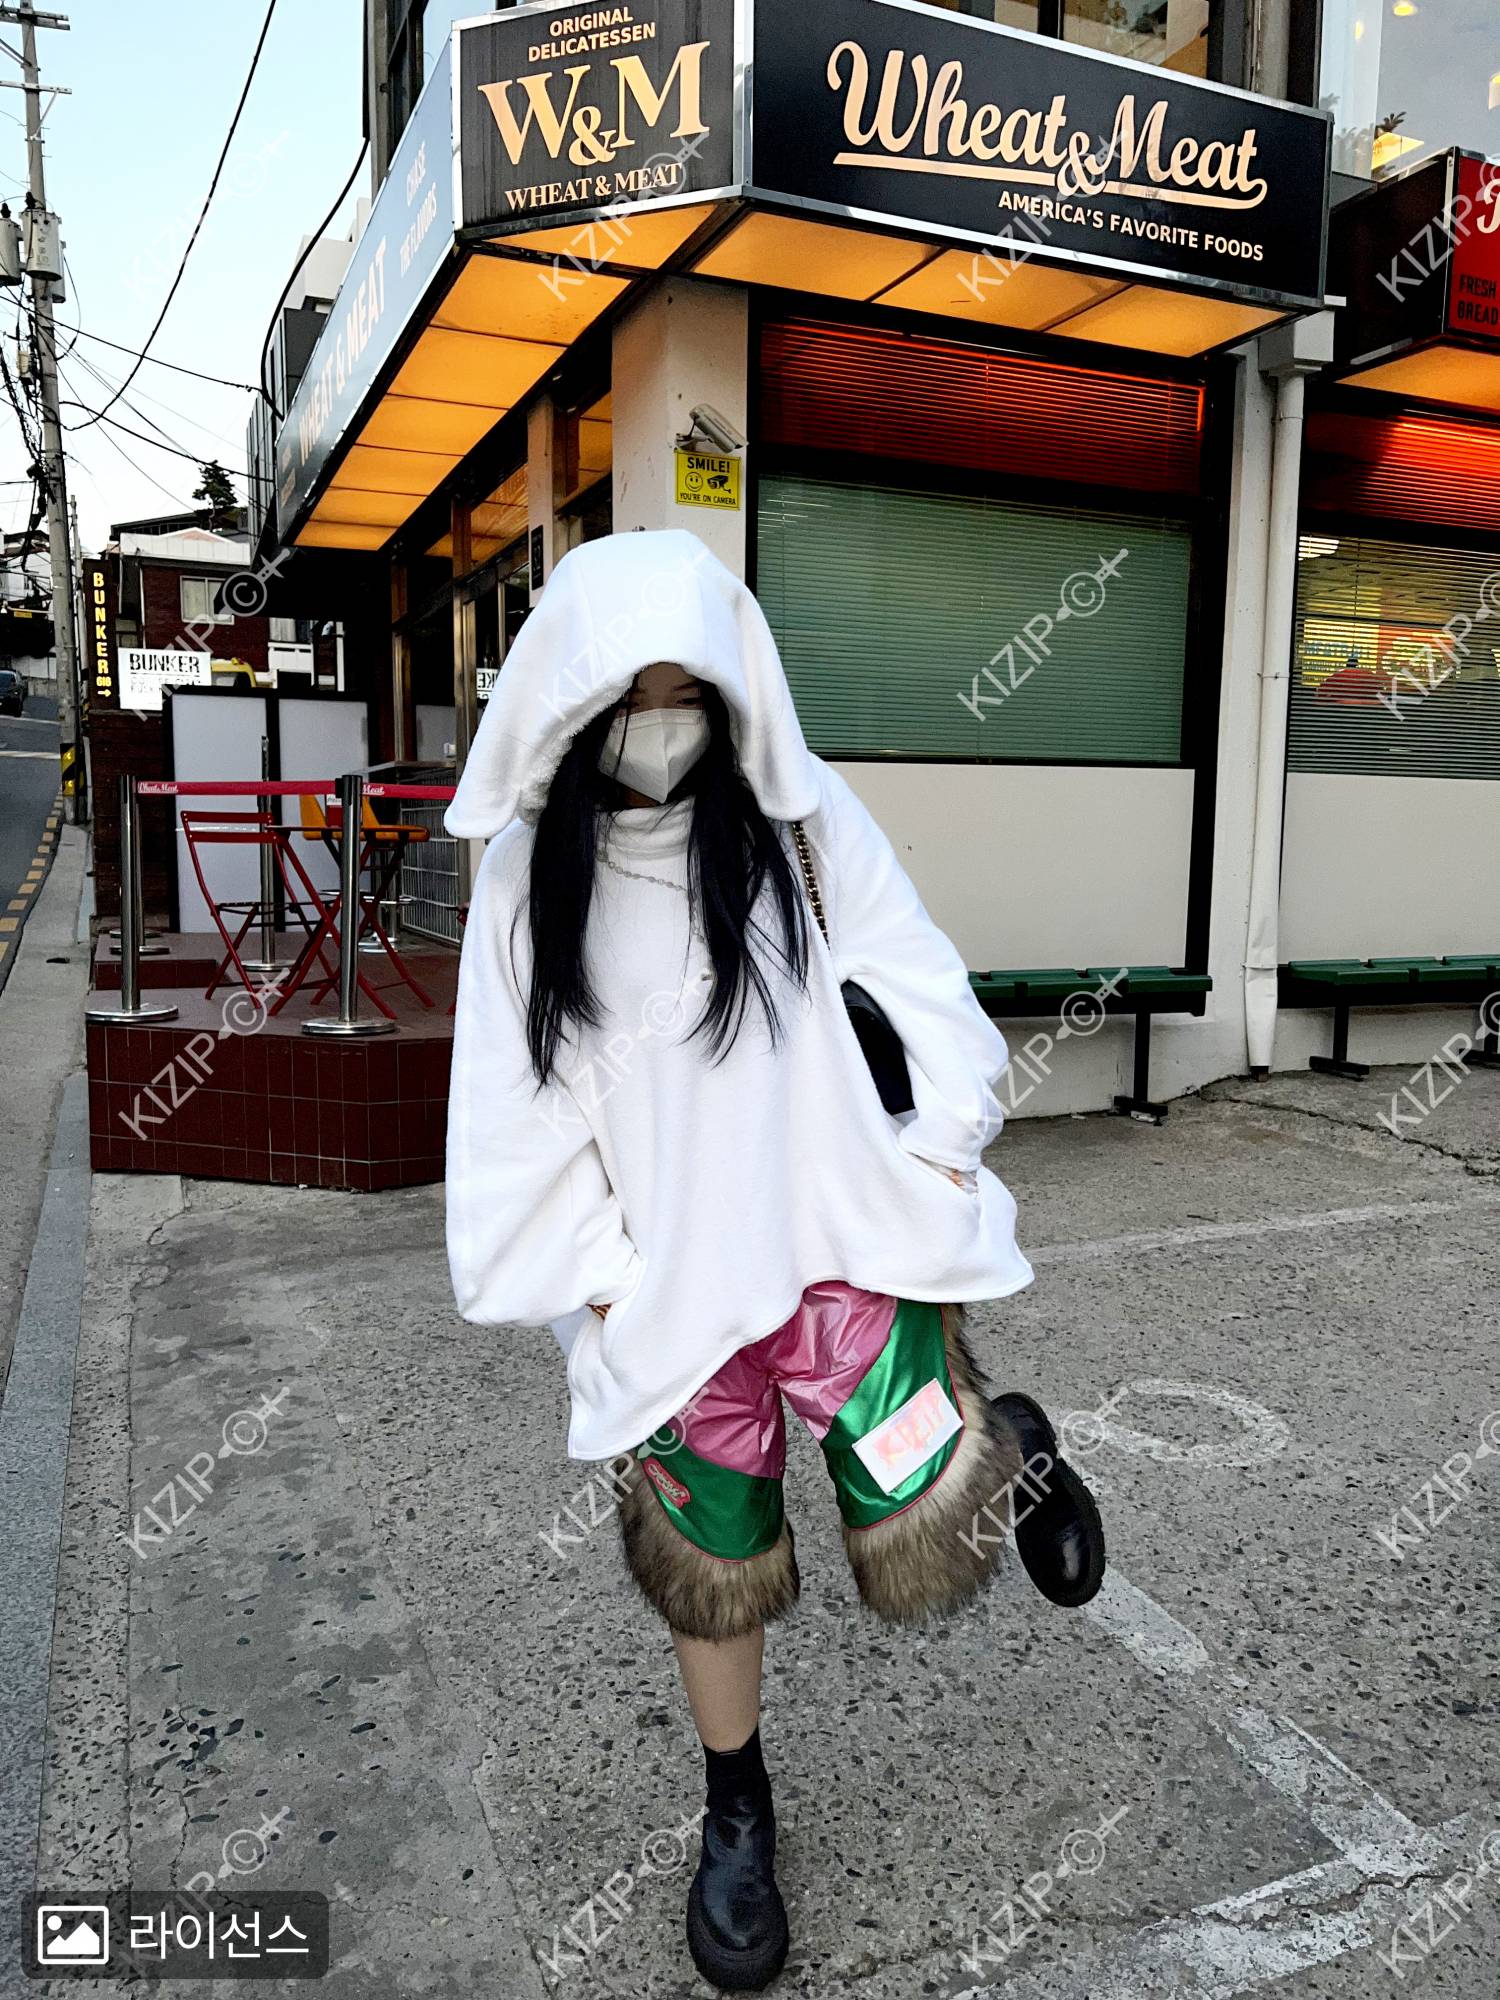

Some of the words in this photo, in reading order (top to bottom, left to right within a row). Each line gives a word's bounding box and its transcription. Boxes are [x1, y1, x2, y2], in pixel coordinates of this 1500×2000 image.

[549, 8, 634, 37] ORIGINAL
[527, 22, 656, 62] DELICATESSEN
[477, 40, 711, 167] W&M
[504, 178, 593, 211] WHEAT
[594, 175, 612, 196] &
[614, 162, 682, 194] MEAT
[1110, 217, 1198, 248] FAVORITE
[1203, 234, 1264, 262] FOODS
[1459, 274, 1497, 300] FRESH
[1457, 301, 1499, 326] BREAD
[299, 357, 334, 466] WHEAT
[335, 333, 346, 397] &
[346, 235, 387, 372] MEAT
[687, 456, 730, 473] SMILE!
[680, 492, 701, 501] YOU'RE
[702, 494, 711, 503] ON
[713, 496, 736, 505] CAMERA
[93, 572, 109, 674] BUNKER
[129, 653, 200, 673] BUNKER
